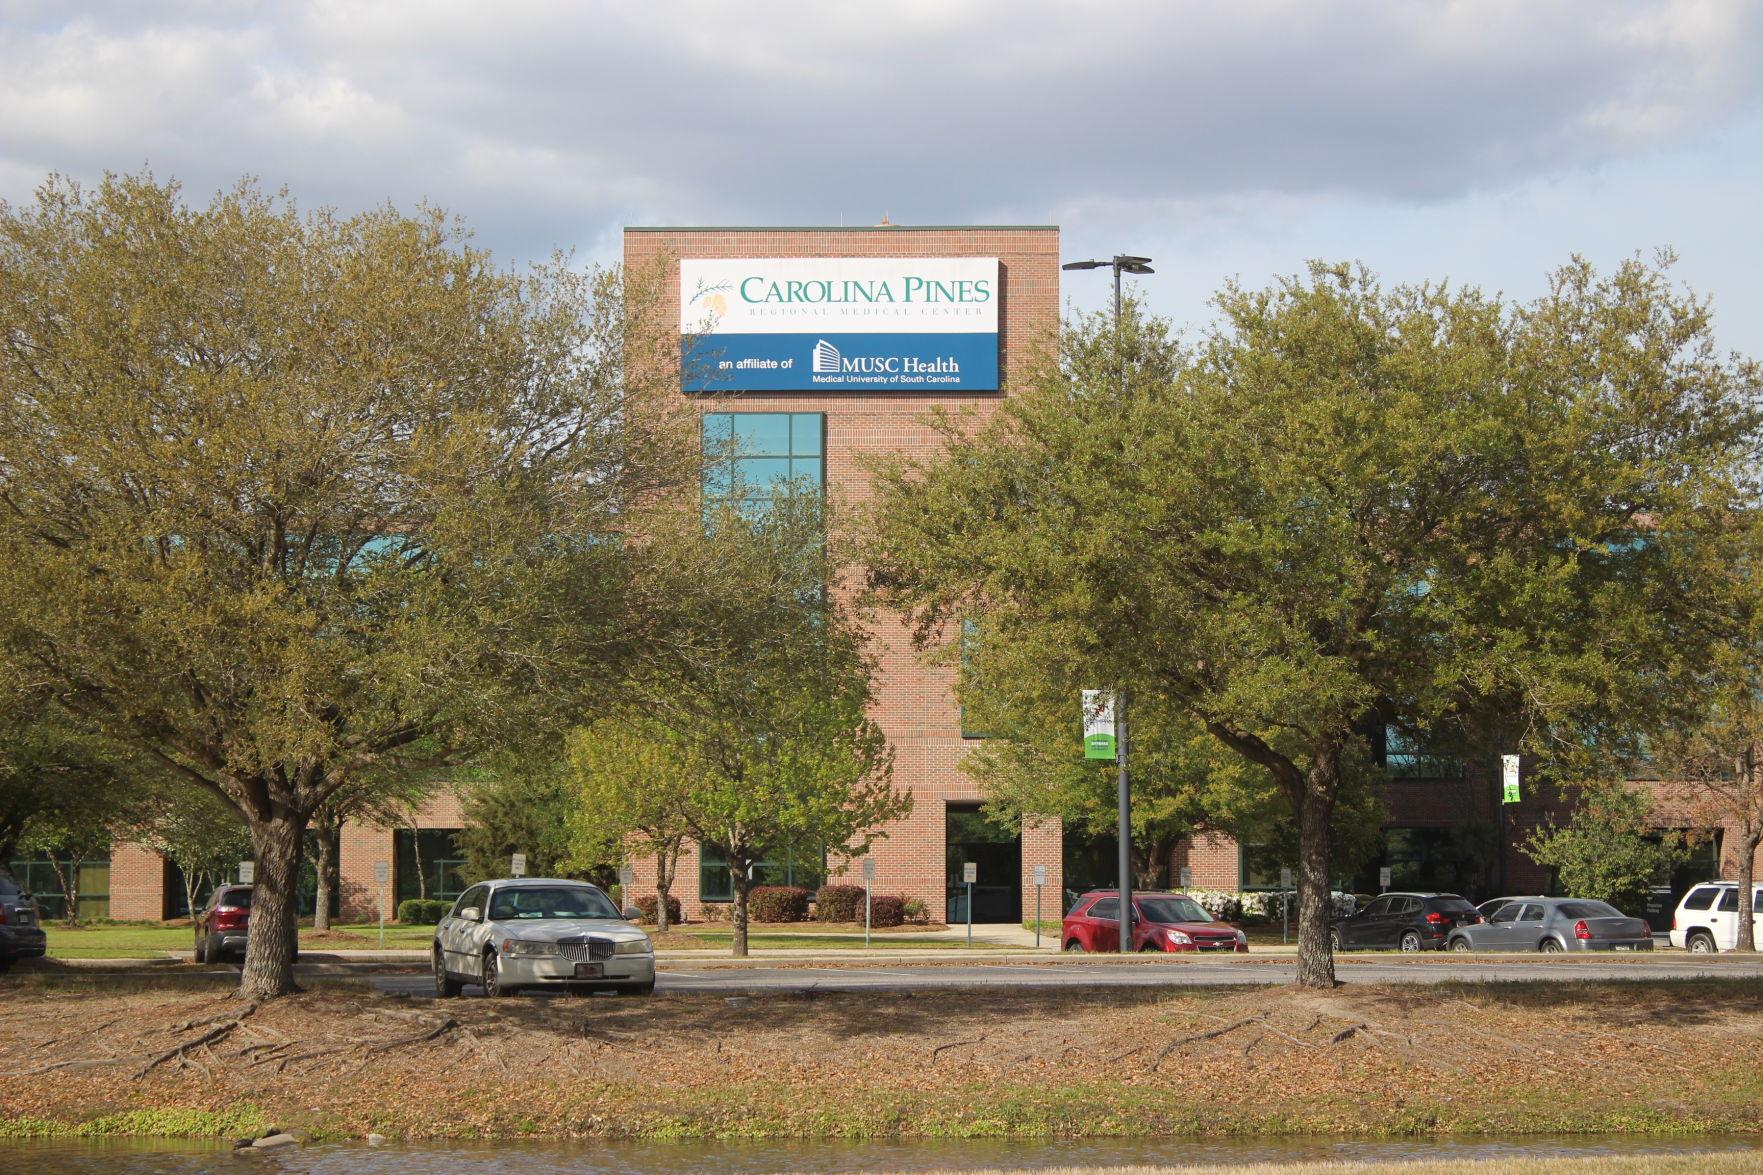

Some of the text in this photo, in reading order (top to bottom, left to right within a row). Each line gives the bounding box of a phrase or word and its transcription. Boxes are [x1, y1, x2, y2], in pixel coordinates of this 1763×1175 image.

[740, 277, 990, 303] CAROLINA PINES
[750, 308, 983, 316] REGIONAL MEDICAL CENTER
[719, 358, 793, 369] an affiliate of
[842, 357, 960, 373] MUSC Health
[812, 375, 961, 384] Medical University of South Carolina
